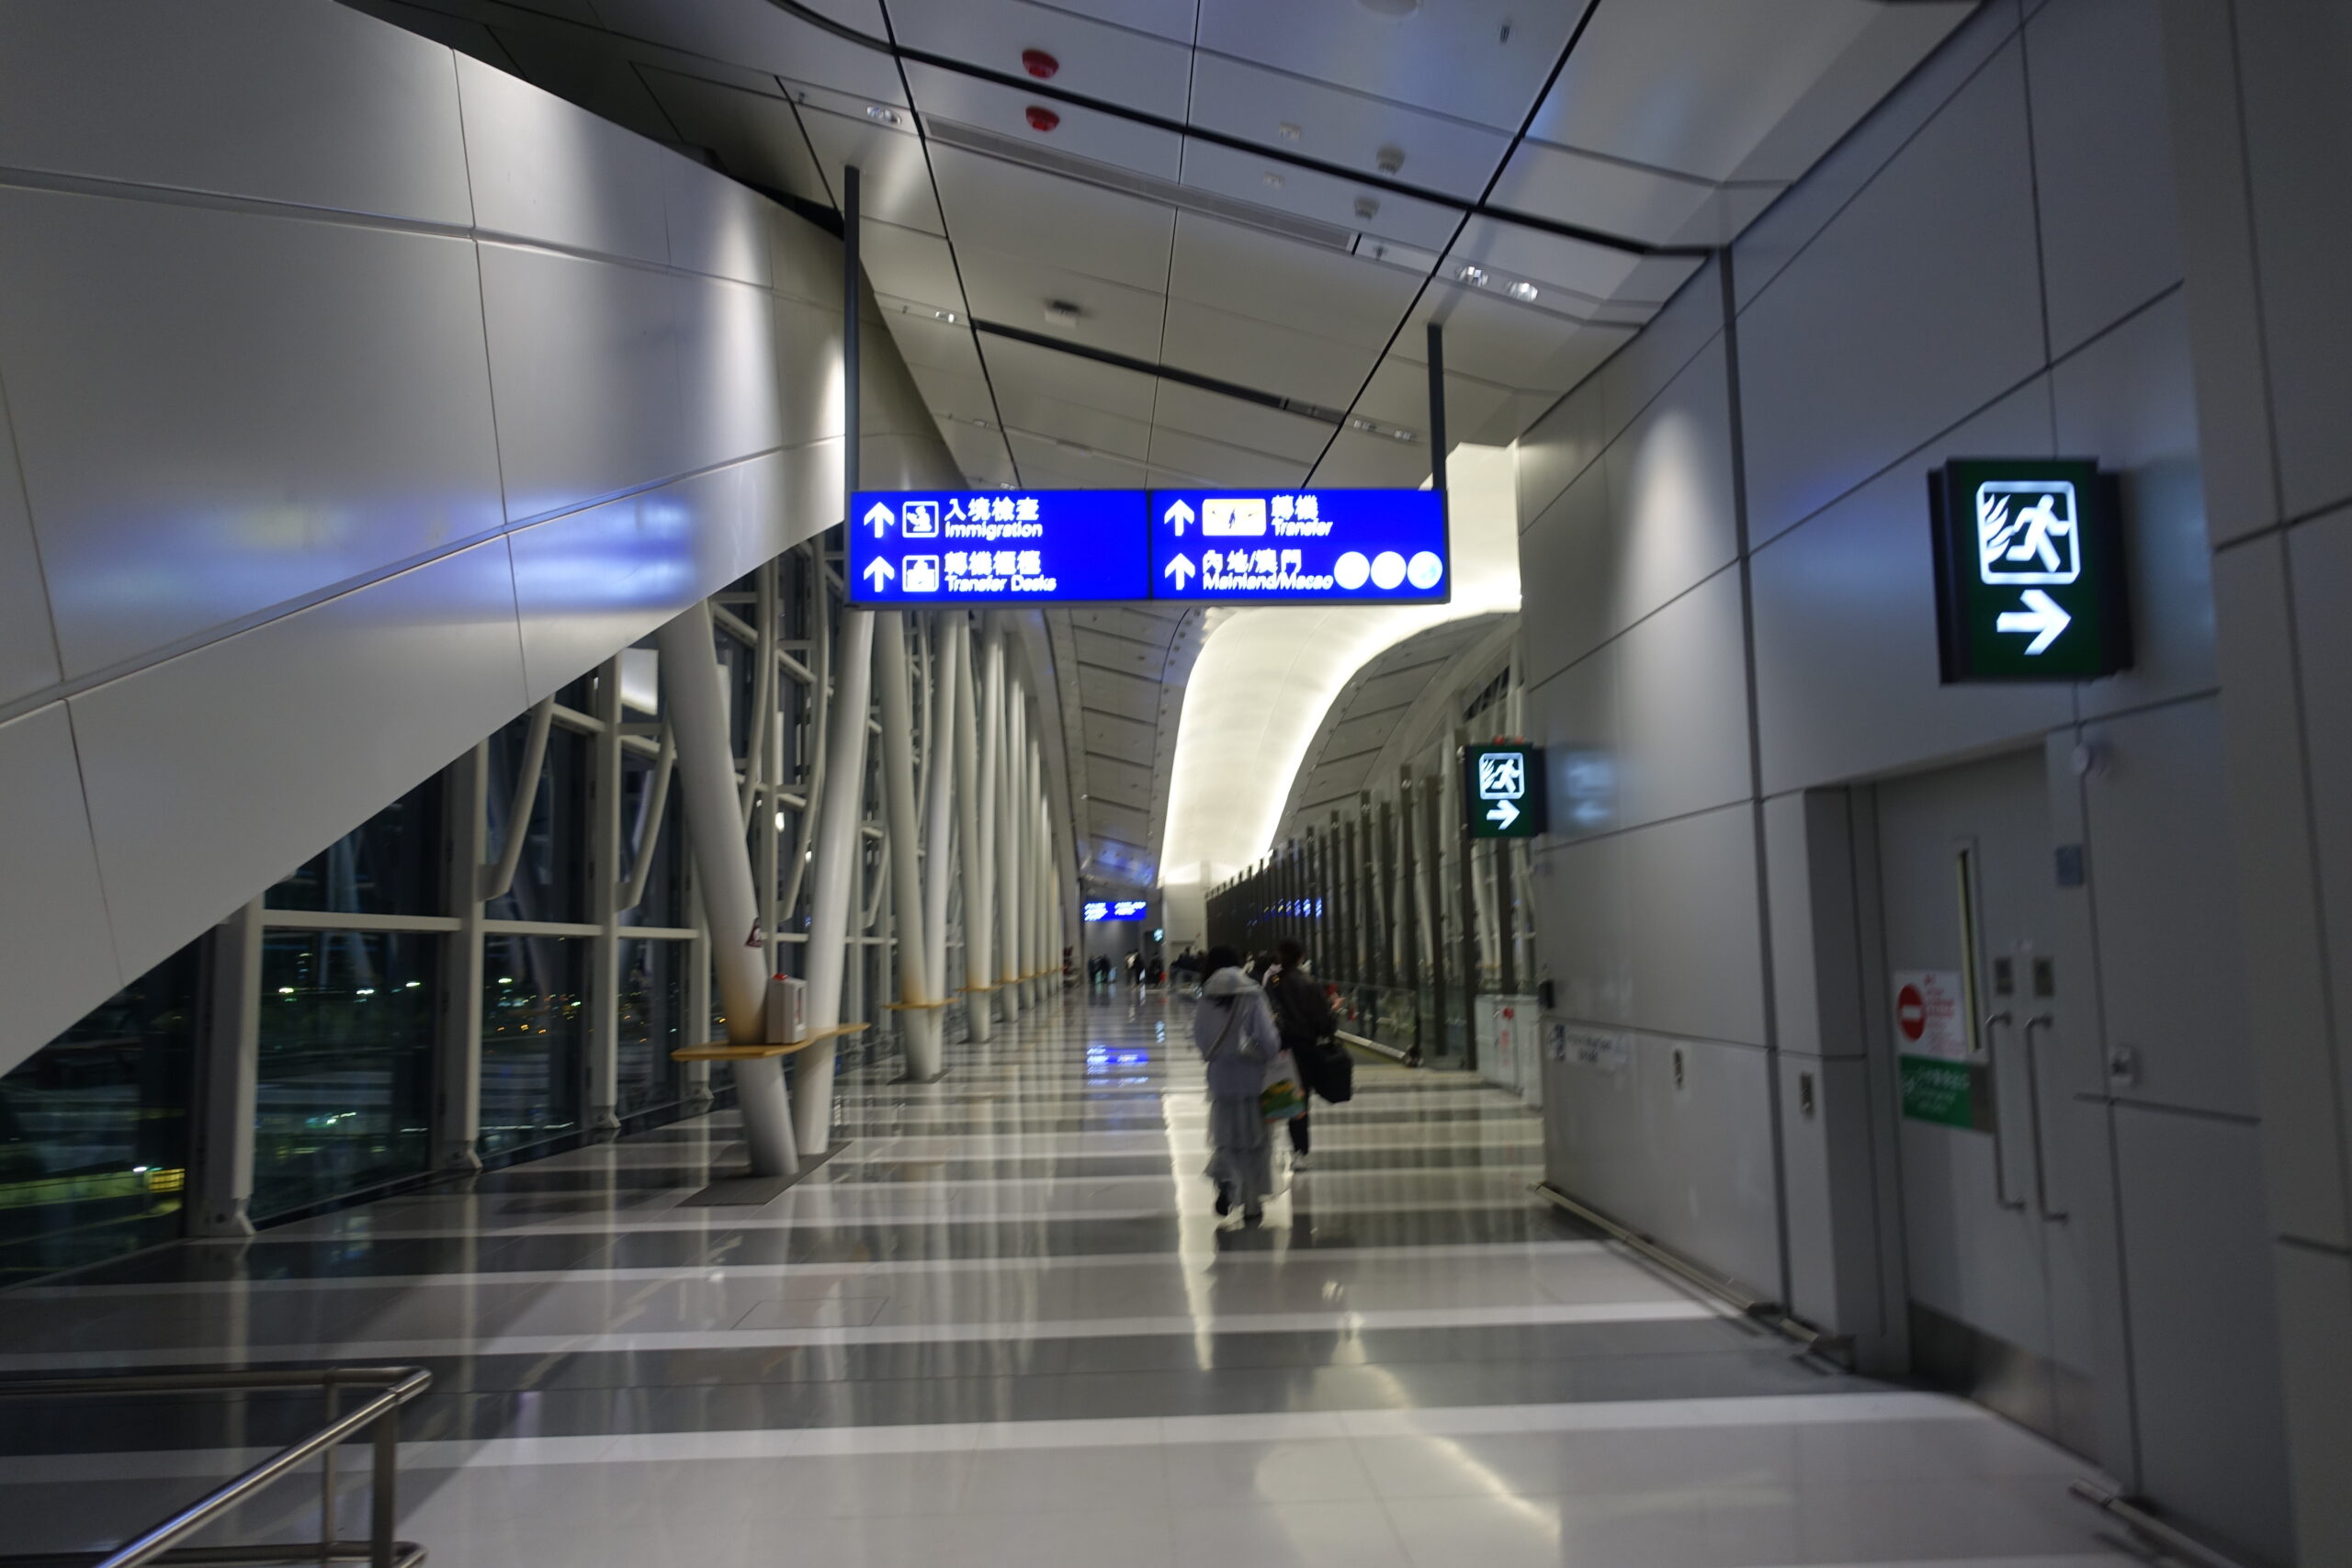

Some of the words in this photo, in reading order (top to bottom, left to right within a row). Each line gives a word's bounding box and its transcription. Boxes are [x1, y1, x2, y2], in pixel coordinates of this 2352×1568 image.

[944, 497, 1039, 522] 入境檢查
[945, 521, 1043, 541] Immigration
[1272, 518, 1333, 536] Transfer
[944, 574, 1007, 592] Transfer
[1011, 574, 1057, 592] Desks
[1203, 572, 1334, 590] Mainland/Macao
